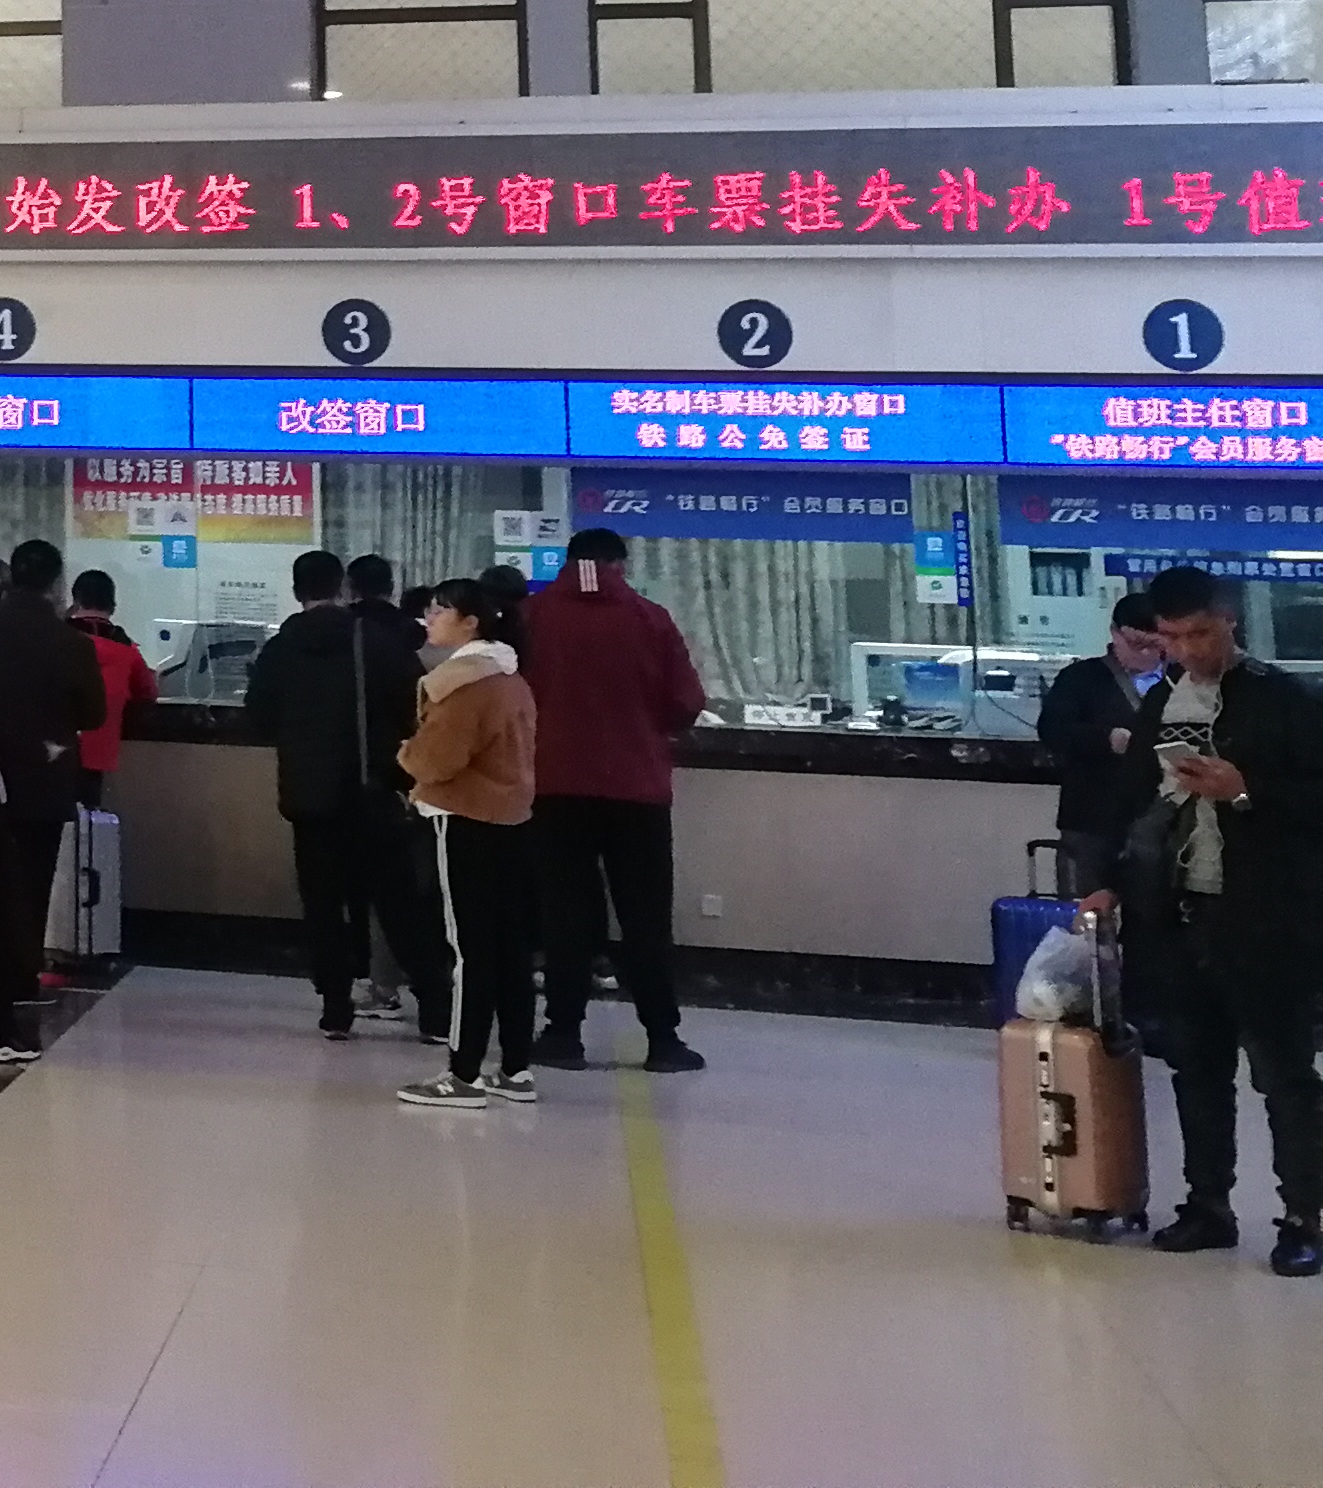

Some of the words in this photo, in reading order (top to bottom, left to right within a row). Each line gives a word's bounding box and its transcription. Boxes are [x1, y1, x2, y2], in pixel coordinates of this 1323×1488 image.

[1121, 167, 1323, 236] 1号值
[342, 311, 371, 354] 3
[740, 311, 771, 356] 2
[1169, 312, 1198, 359] 1
[278, 397, 426, 435] 改签窗口
[610, 389, 906, 416] 实名制车票挂失补办窗口
[1102, 397, 1308, 429] 值班主任窗口
[636, 423, 871, 451] 铁路公免签证
